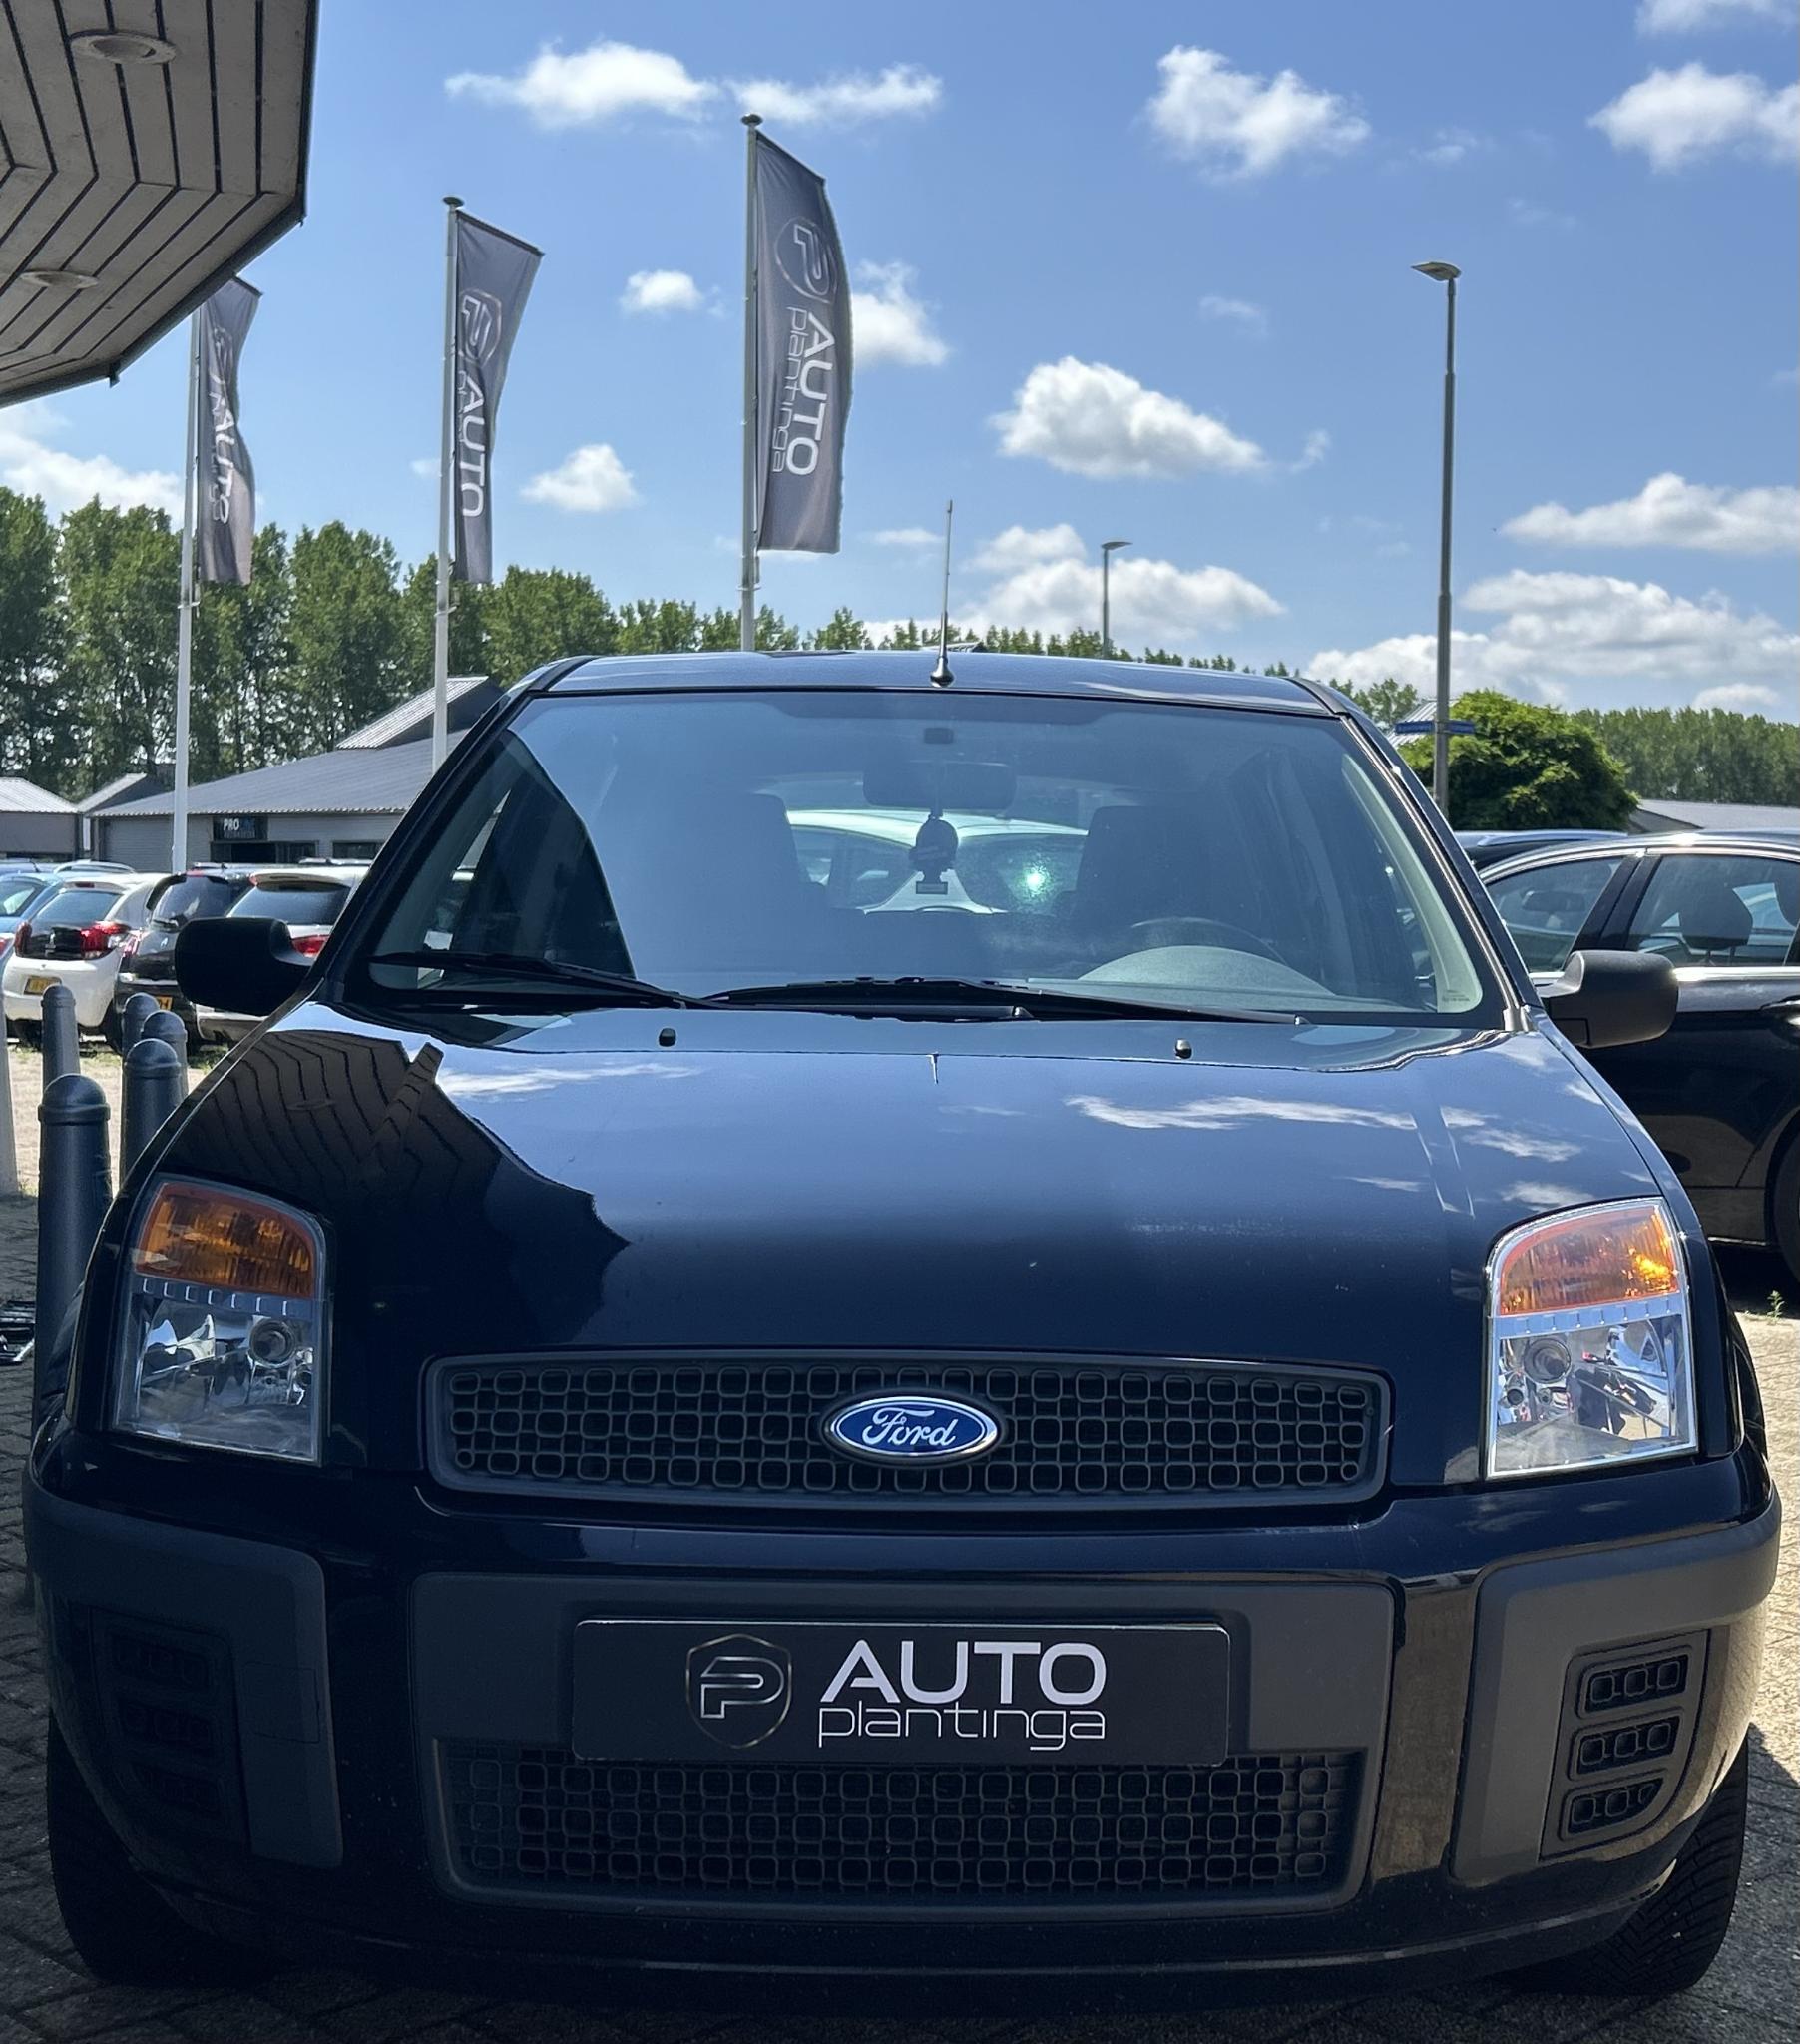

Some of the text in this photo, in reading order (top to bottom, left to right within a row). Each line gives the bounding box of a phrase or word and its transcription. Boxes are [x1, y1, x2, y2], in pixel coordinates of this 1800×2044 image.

[772, 306, 809, 473] plantinga
[786, 311, 835, 476] AUTO
[460, 374, 486, 517] AUTO
[861, 1406, 959, 1446] Ford
[819, 1639, 1107, 1705] AUTO
[818, 1700, 1106, 1751] plantinga
